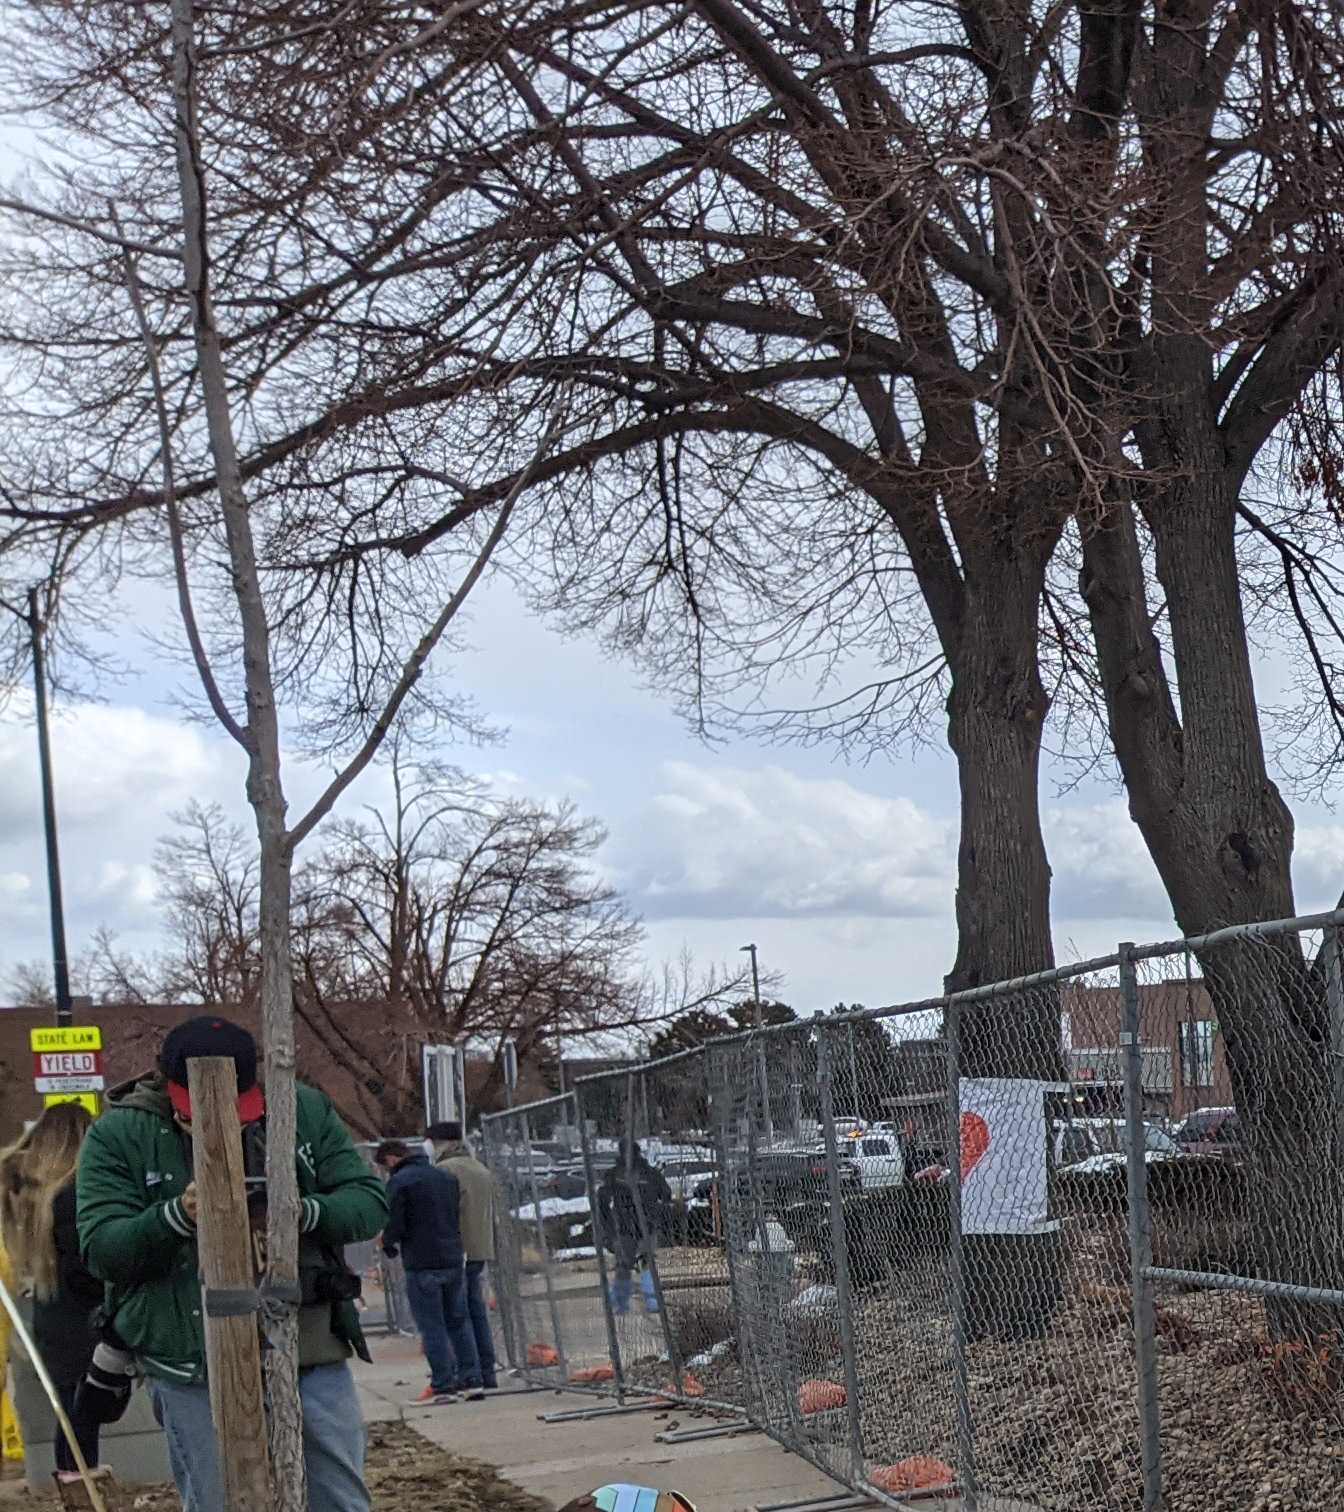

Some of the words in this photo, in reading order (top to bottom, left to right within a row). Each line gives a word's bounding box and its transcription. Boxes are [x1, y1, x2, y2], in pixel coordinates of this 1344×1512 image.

[37, 1032, 68, 1045] STATE
[72, 1032, 93, 1044] LAW
[44, 1055, 92, 1072] YIELD
